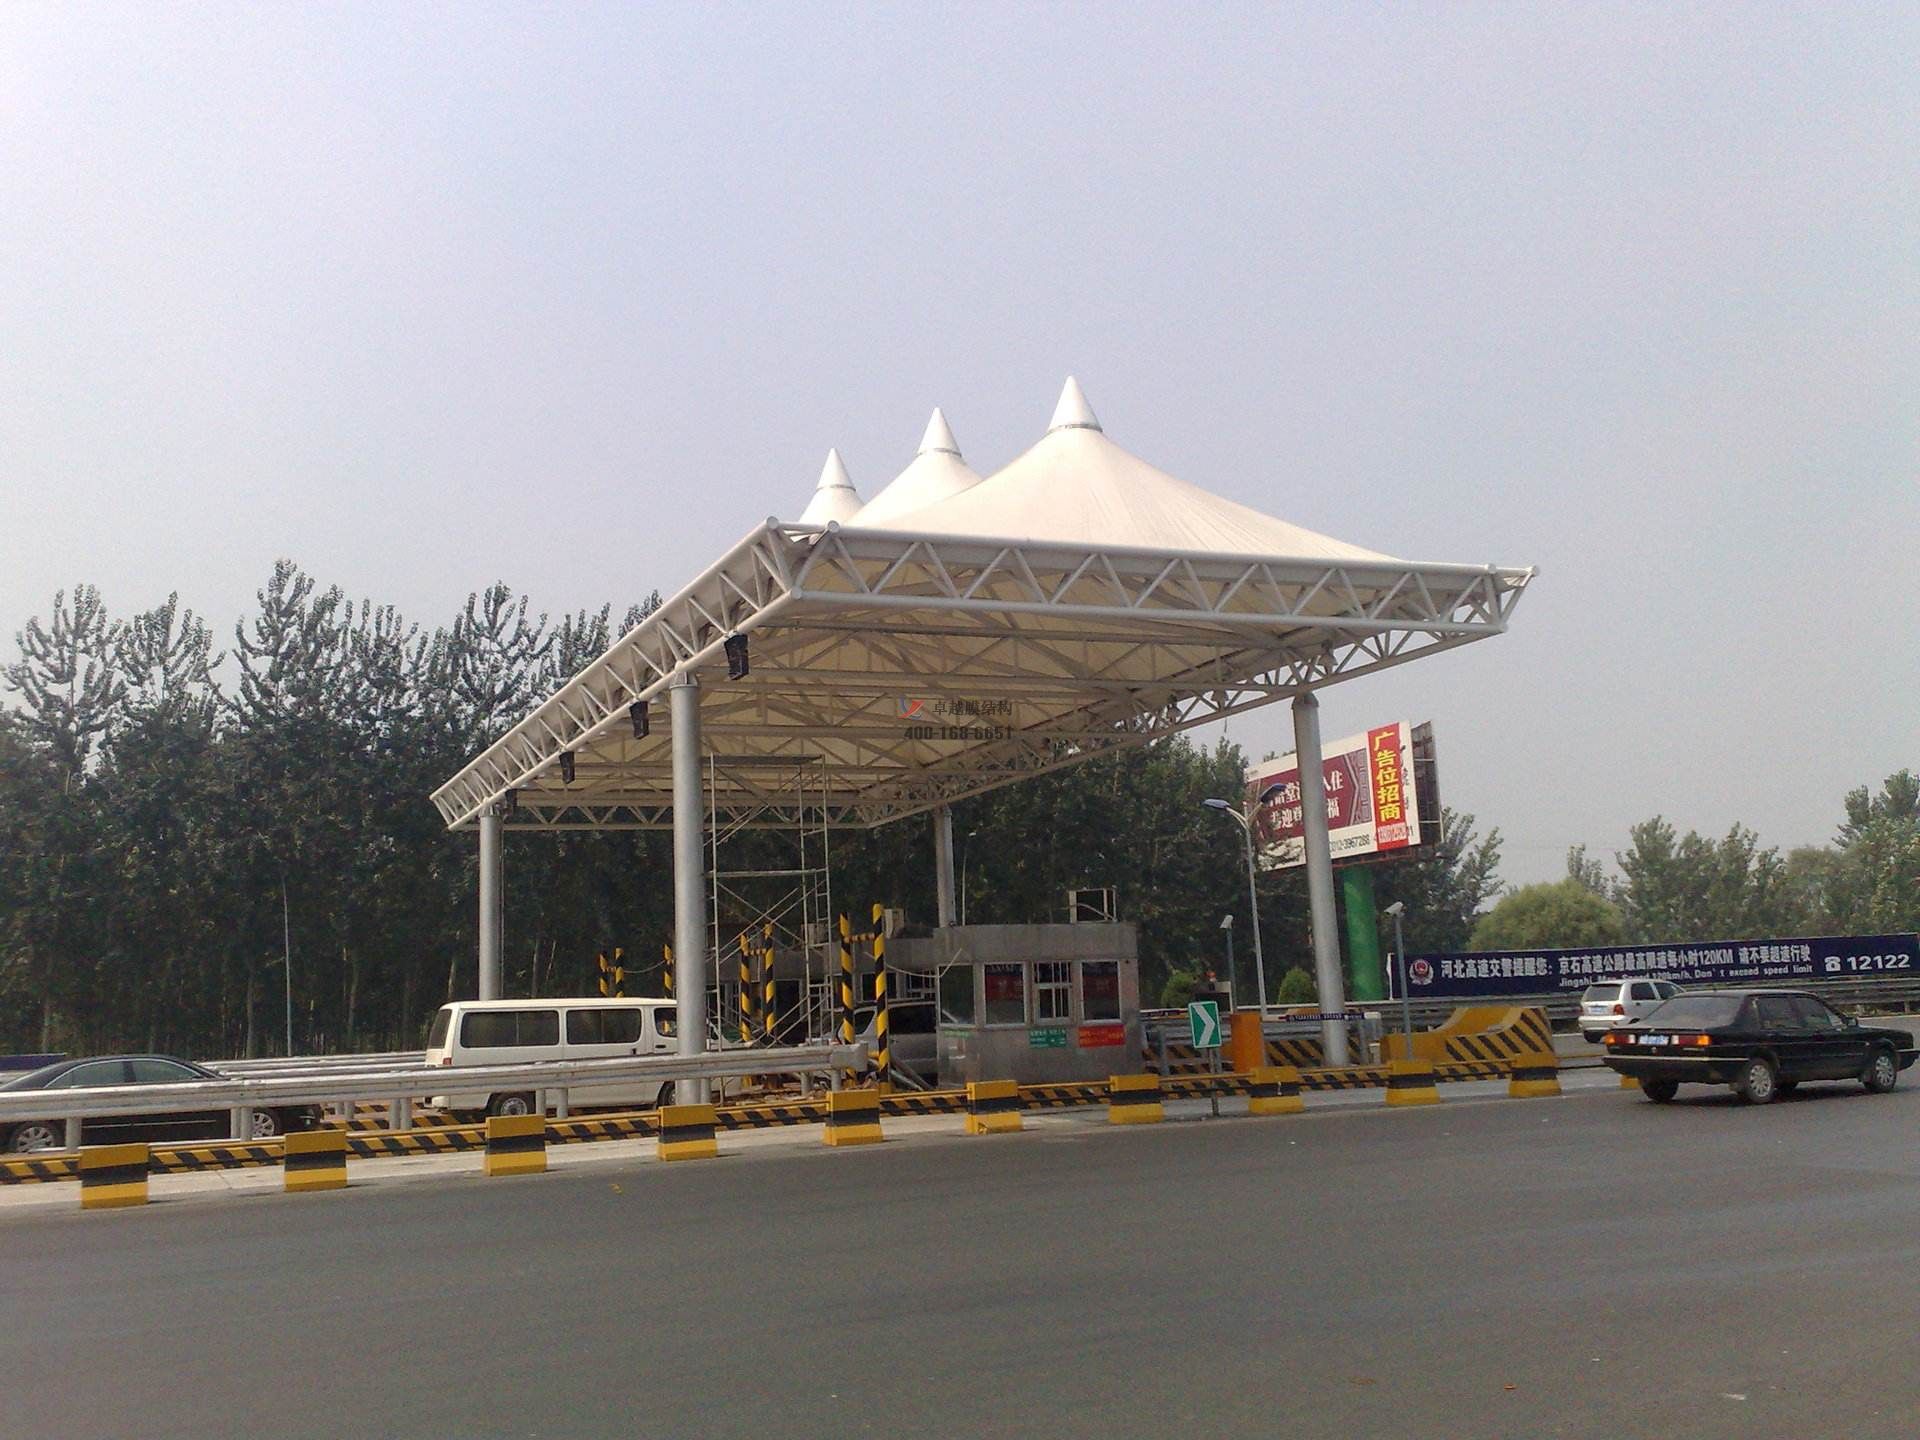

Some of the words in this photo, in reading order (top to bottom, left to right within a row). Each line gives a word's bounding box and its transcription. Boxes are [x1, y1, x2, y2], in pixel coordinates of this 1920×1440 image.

[1373, 731, 1401, 822] 广告位招商
[1729, 966, 1759, 978] exceed
[1763, 963, 1788, 976] speed
[1793, 964, 1813, 974] limit
[1847, 954, 1911, 971] 12122
